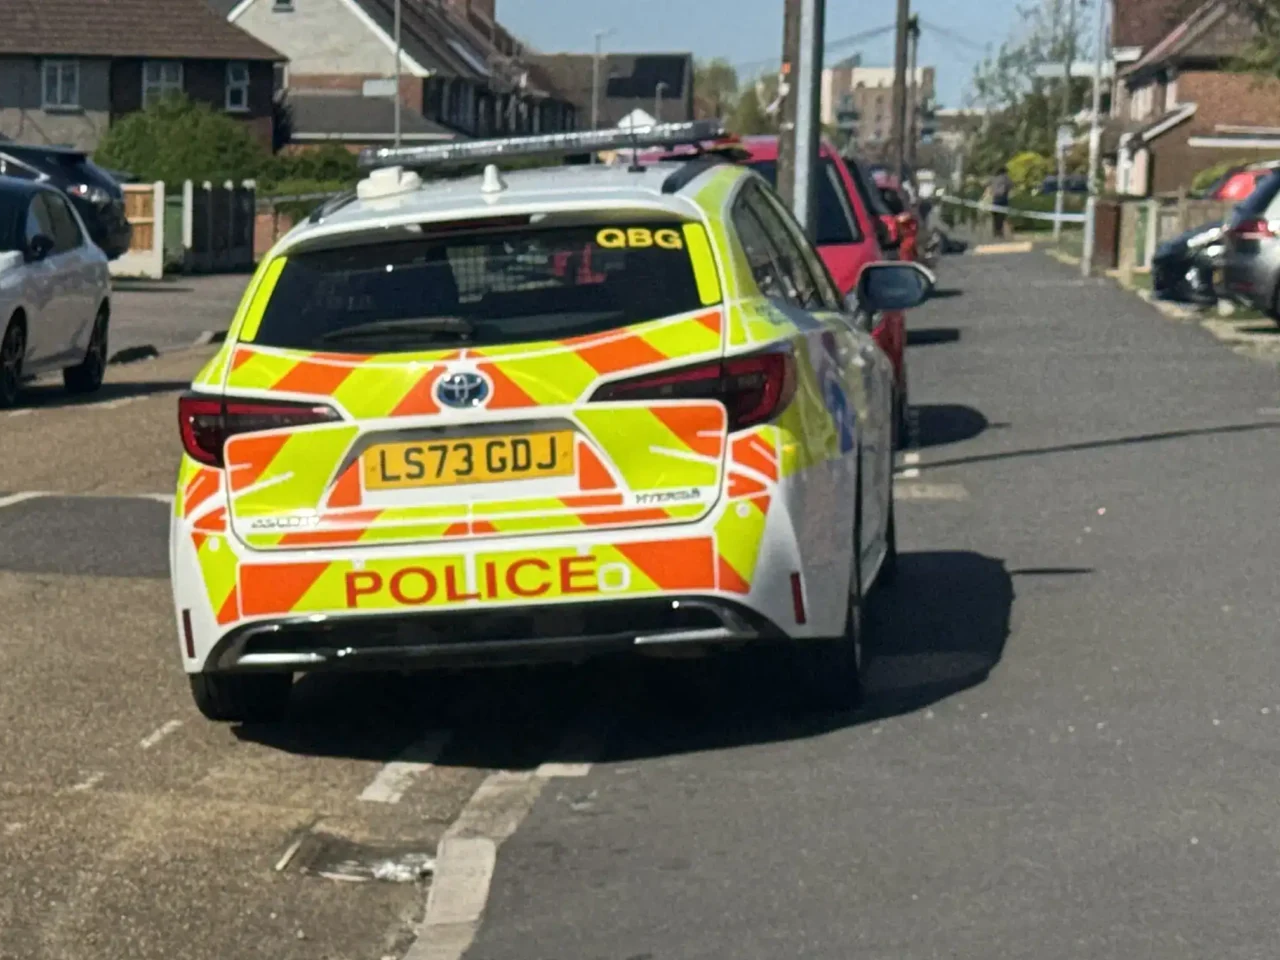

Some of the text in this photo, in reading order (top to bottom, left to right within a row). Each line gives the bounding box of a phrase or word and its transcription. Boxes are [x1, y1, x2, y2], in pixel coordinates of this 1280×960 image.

[596, 228, 683, 250] QBG
[379, 437, 557, 482] LS73 GDJ
[345, 555, 600, 608] POLICE
